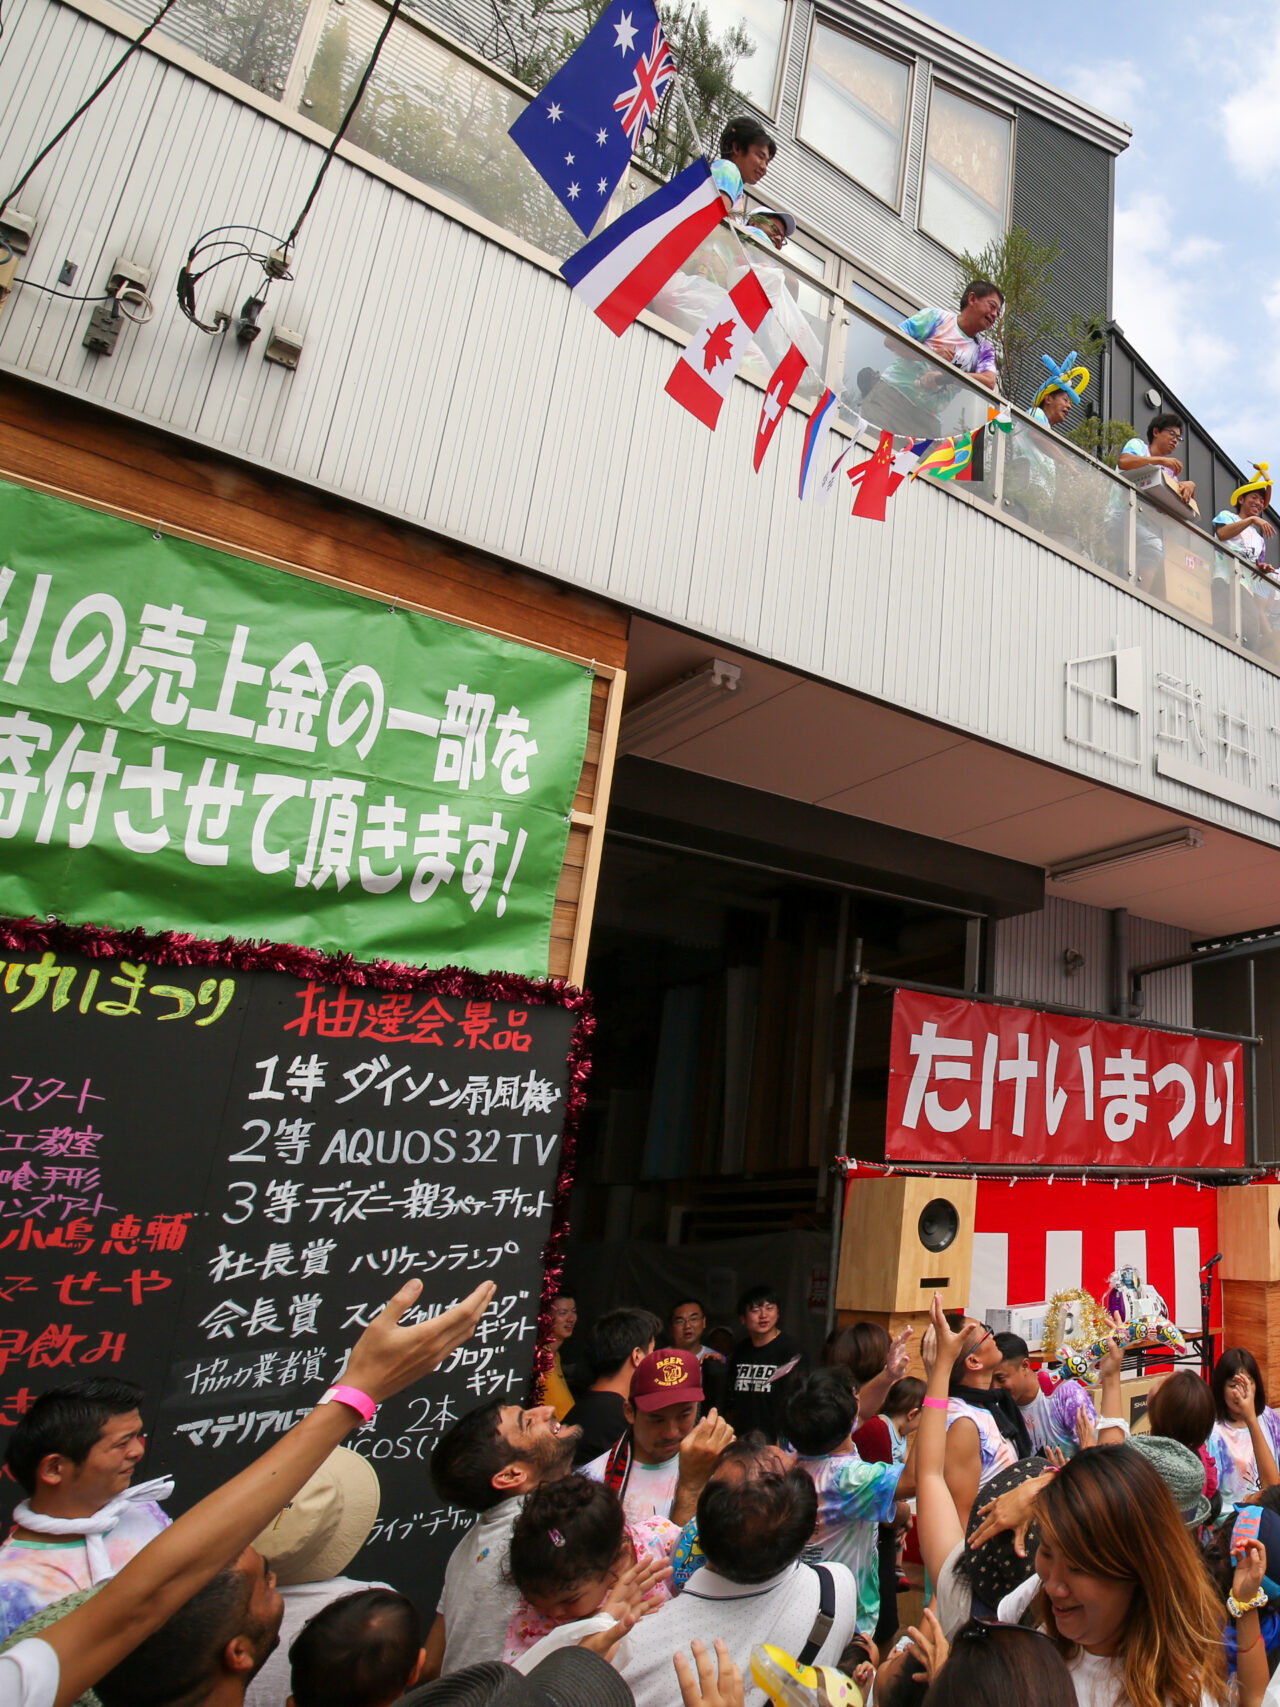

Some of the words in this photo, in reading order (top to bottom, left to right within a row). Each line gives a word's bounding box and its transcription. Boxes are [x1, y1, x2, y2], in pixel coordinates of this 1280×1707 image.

[0, 951, 235, 1026] けいまつり
[283, 981, 532, 1052] 抽選会景品
[0, 1075, 106, 1114] スタート
[249, 1054, 329, 1103] 1等
[335, 1054, 562, 1116] ダイソン扇風機
[901, 1020, 1234, 1145] たけいまつり
[0, 1124, 104, 1159] 工教室
[227, 1117, 316, 1165] 2等
[319, 1127, 456, 1166] AQUOS
[462, 1129, 501, 1164] 32
[506, 1132, 558, 1166] TV
[0, 1193, 118, 1220] ンズアート
[222, 1179, 304, 1225] 3等
[208, 1238, 338, 1283] 社長賞
[350, 1240, 520, 1275] ハリケーンランプ
[52, 1268, 173, 1306] せーや
[198, 1293, 323, 1340] 会長賞
[474, 1316, 537, 1343] ギフト
[433, 1346, 506, 1373] タログ
[656, 1357, 684, 1369] BEER
[466, 1369, 524, 1396] ギフト
